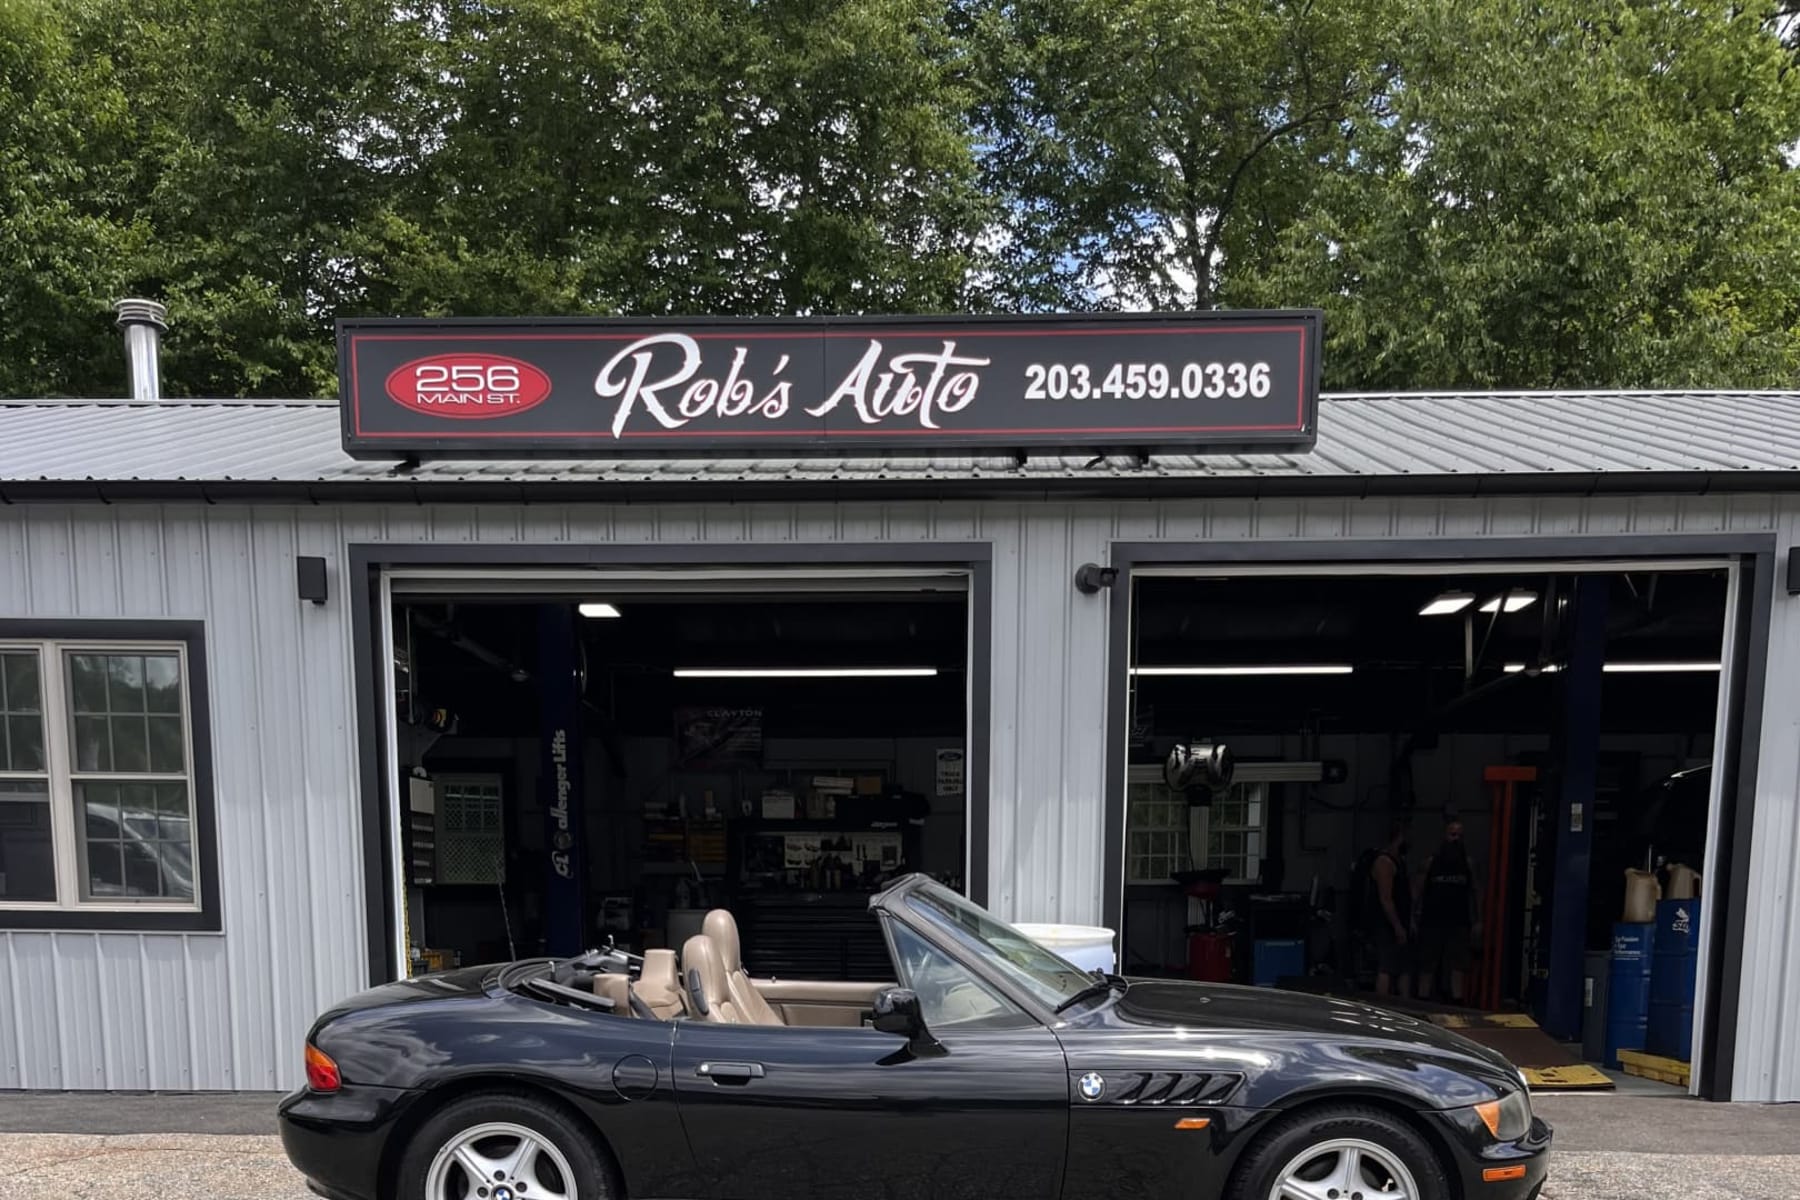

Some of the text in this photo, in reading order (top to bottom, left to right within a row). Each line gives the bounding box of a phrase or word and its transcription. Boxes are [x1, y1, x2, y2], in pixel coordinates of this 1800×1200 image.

[415, 365, 520, 392] 256
[594, 333, 991, 440] Rob's Auto
[1024, 362, 1271, 400] 203.459.0336
[417, 393, 521, 404] MAIN ST.
[552, 729, 567, 762] Lifts
